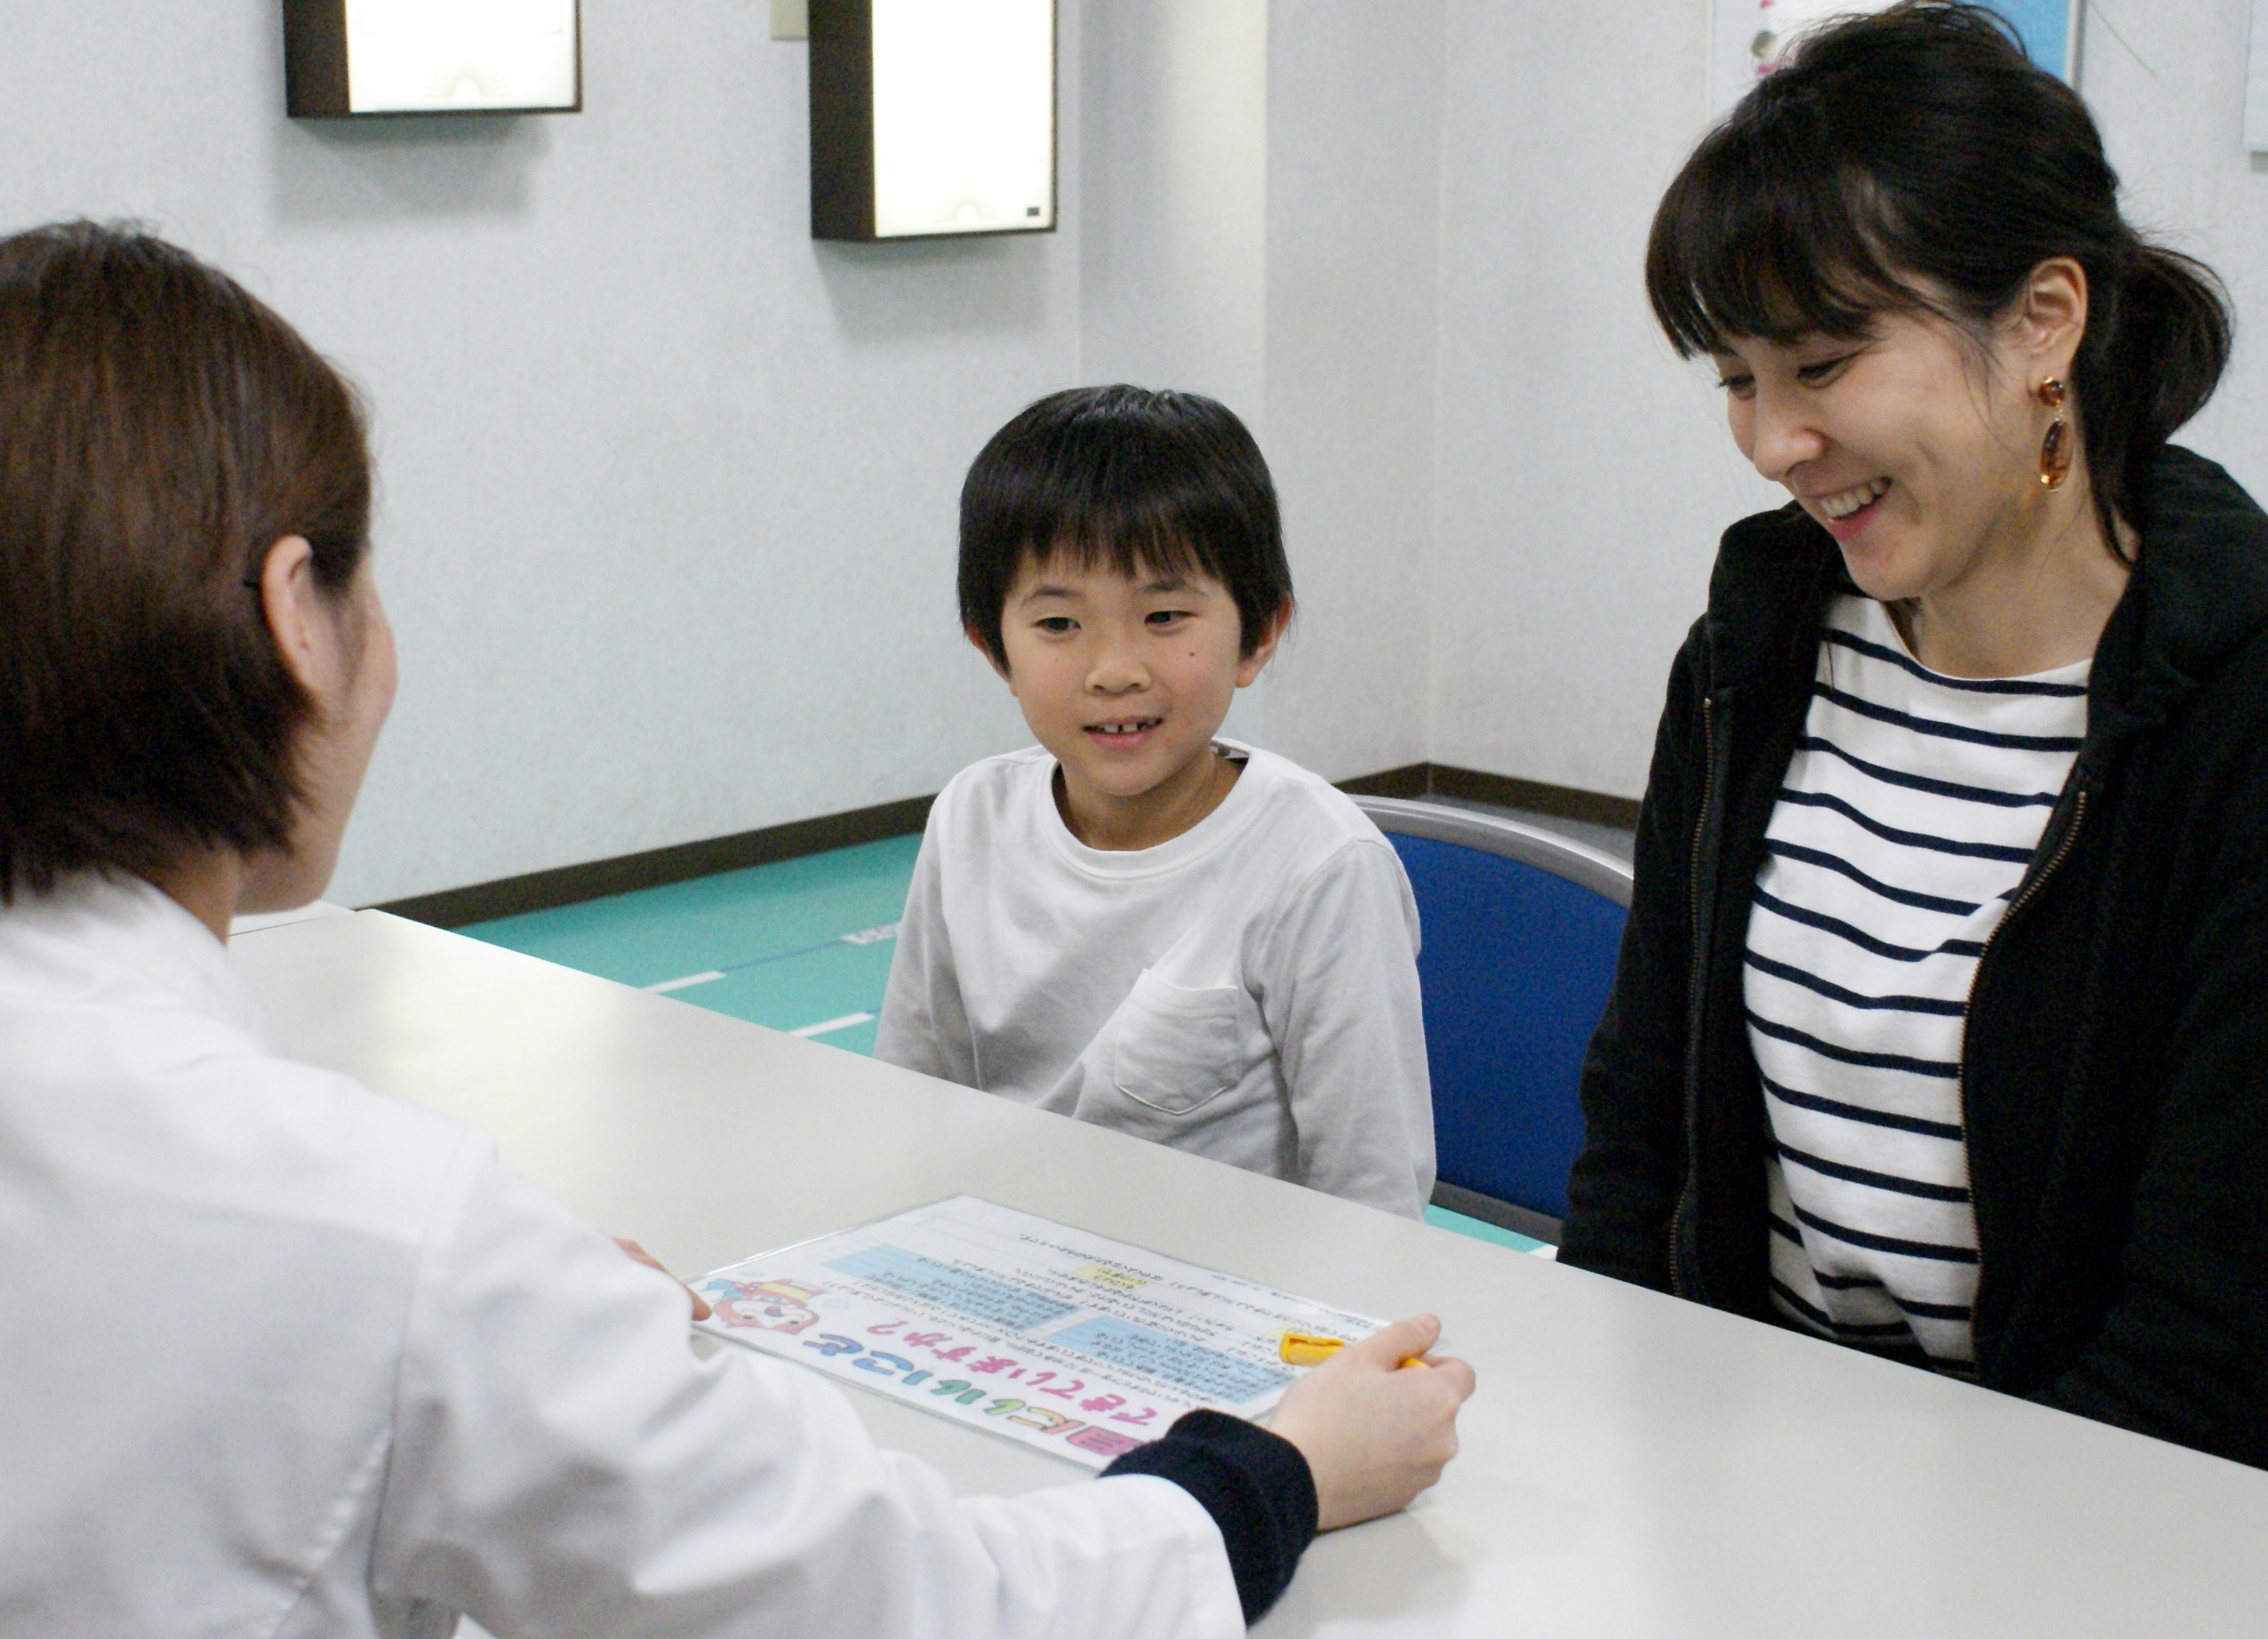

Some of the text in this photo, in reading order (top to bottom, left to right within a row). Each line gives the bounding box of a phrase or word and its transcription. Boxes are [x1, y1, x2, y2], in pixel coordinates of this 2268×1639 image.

[804, 1333, 1143, 1456] 目にいいこと
[867, 1319, 1158, 1426] できていますか？
